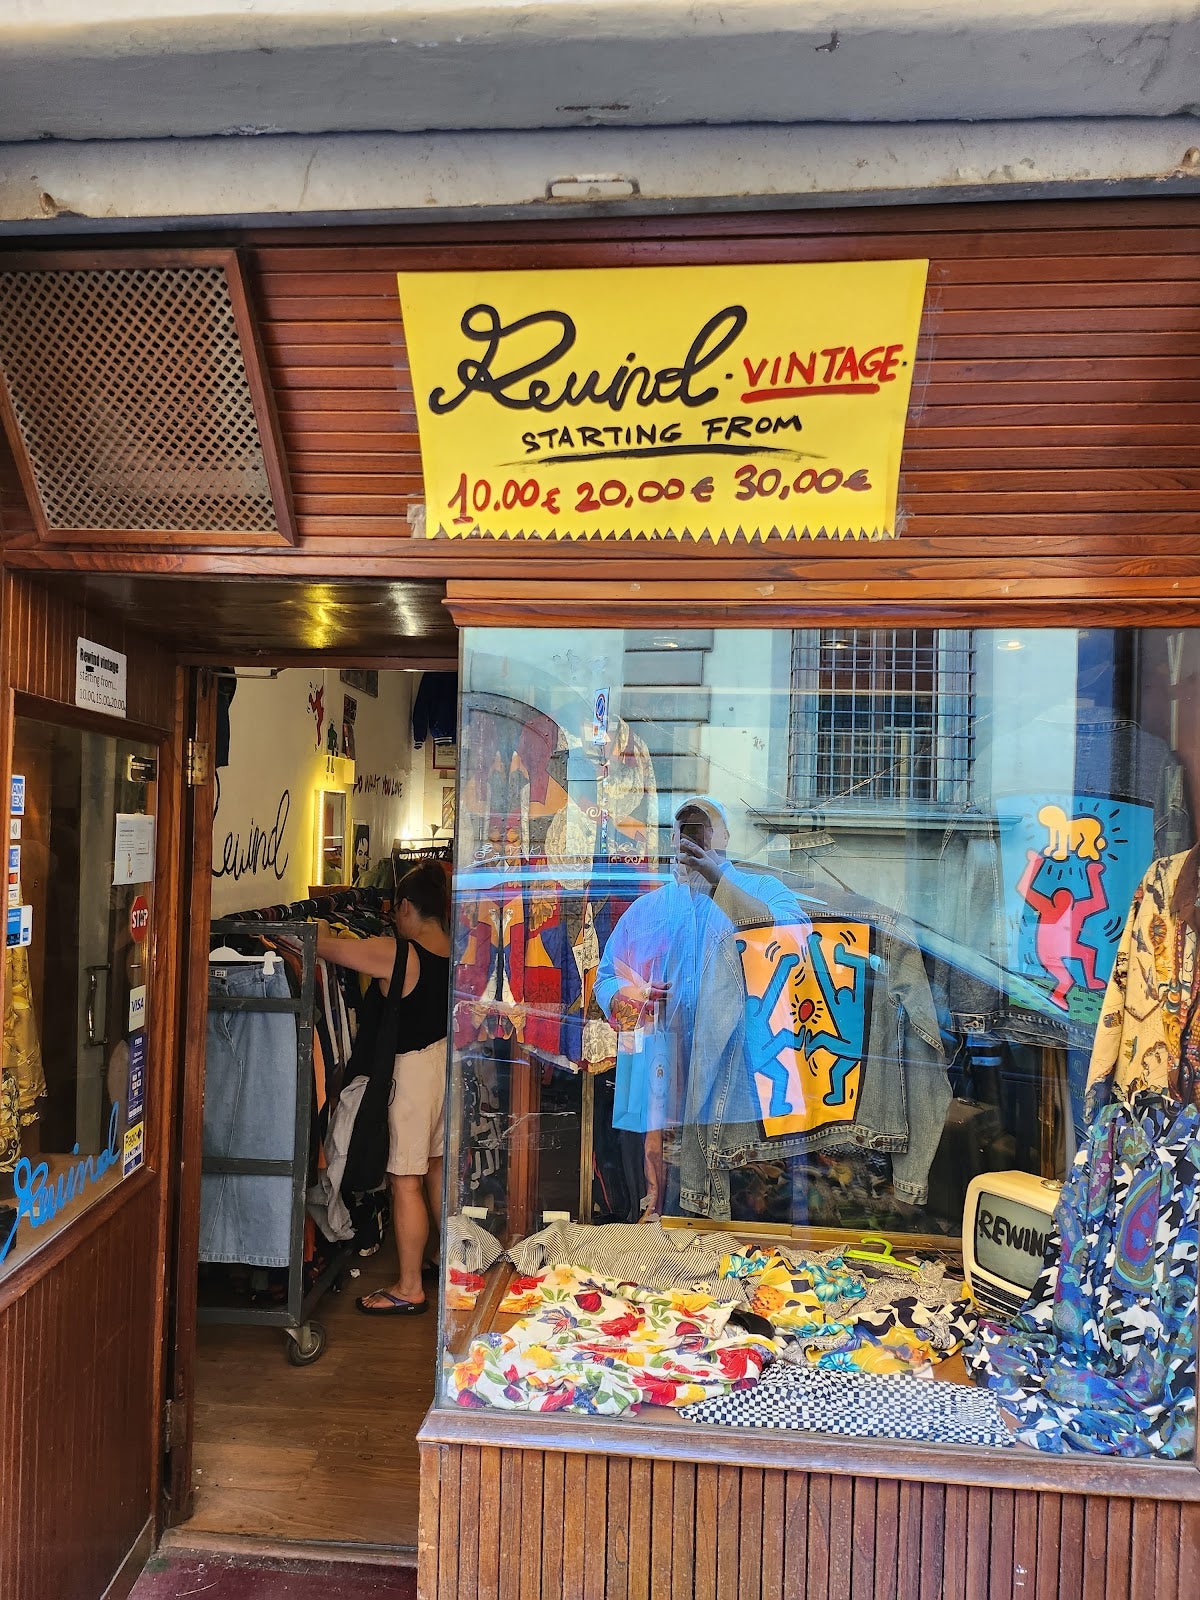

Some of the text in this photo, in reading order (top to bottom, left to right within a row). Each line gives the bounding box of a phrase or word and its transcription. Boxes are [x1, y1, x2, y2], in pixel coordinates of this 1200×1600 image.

[428, 303, 748, 415] Rewind
[521, 415, 803, 453] STARTING FROM
[131, 908, 149, 929] STOP
[131, 997, 144, 1012] VISA
[978, 1209, 1048, 1258] REWIN
